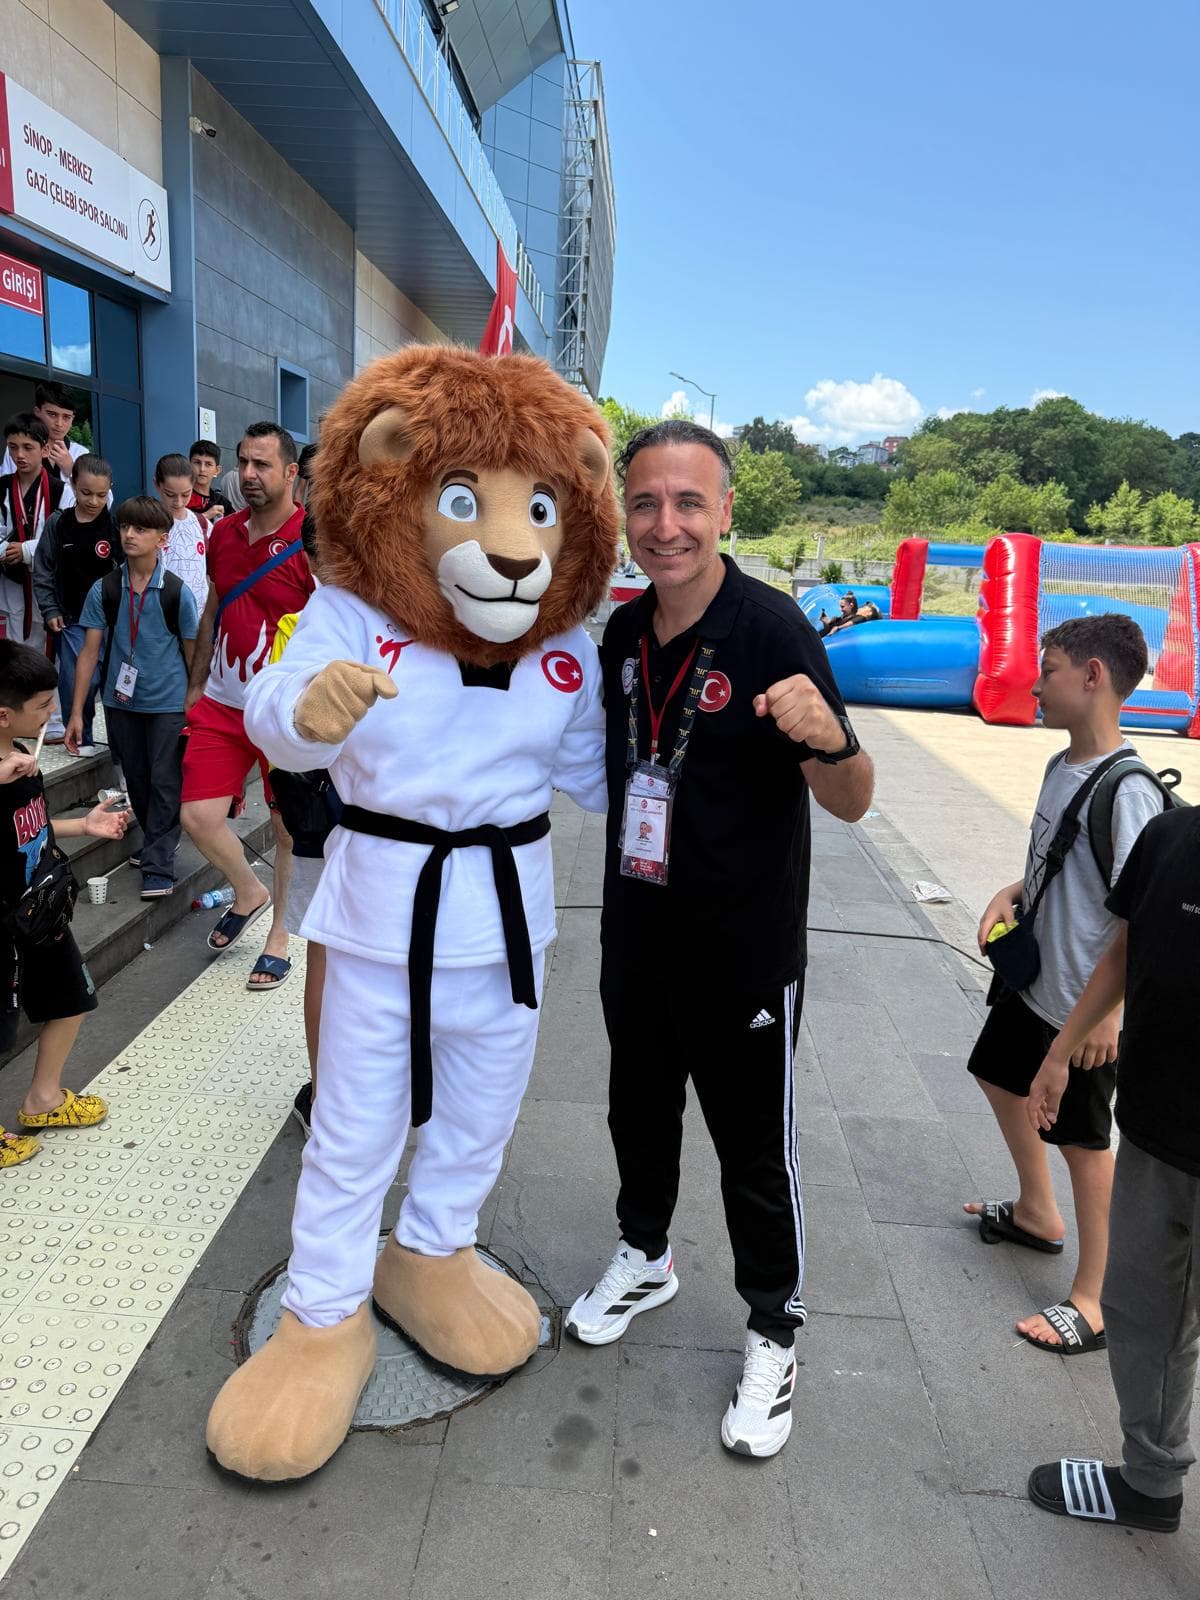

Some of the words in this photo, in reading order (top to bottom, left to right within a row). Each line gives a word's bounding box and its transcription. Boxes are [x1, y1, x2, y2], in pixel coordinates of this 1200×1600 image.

[23, 122, 53, 157] SİNOP
[59, 147, 94, 186] MERKEZ
[26, 167, 49, 196] GAZİ
[49, 181, 78, 212] ÇELEBİ
[78, 197, 100, 225] SPOR
[100, 210, 129, 241] SALONU
[2, 267, 37, 303] GİRİŞİ
[1043, 1307, 1078, 1346] UMA
